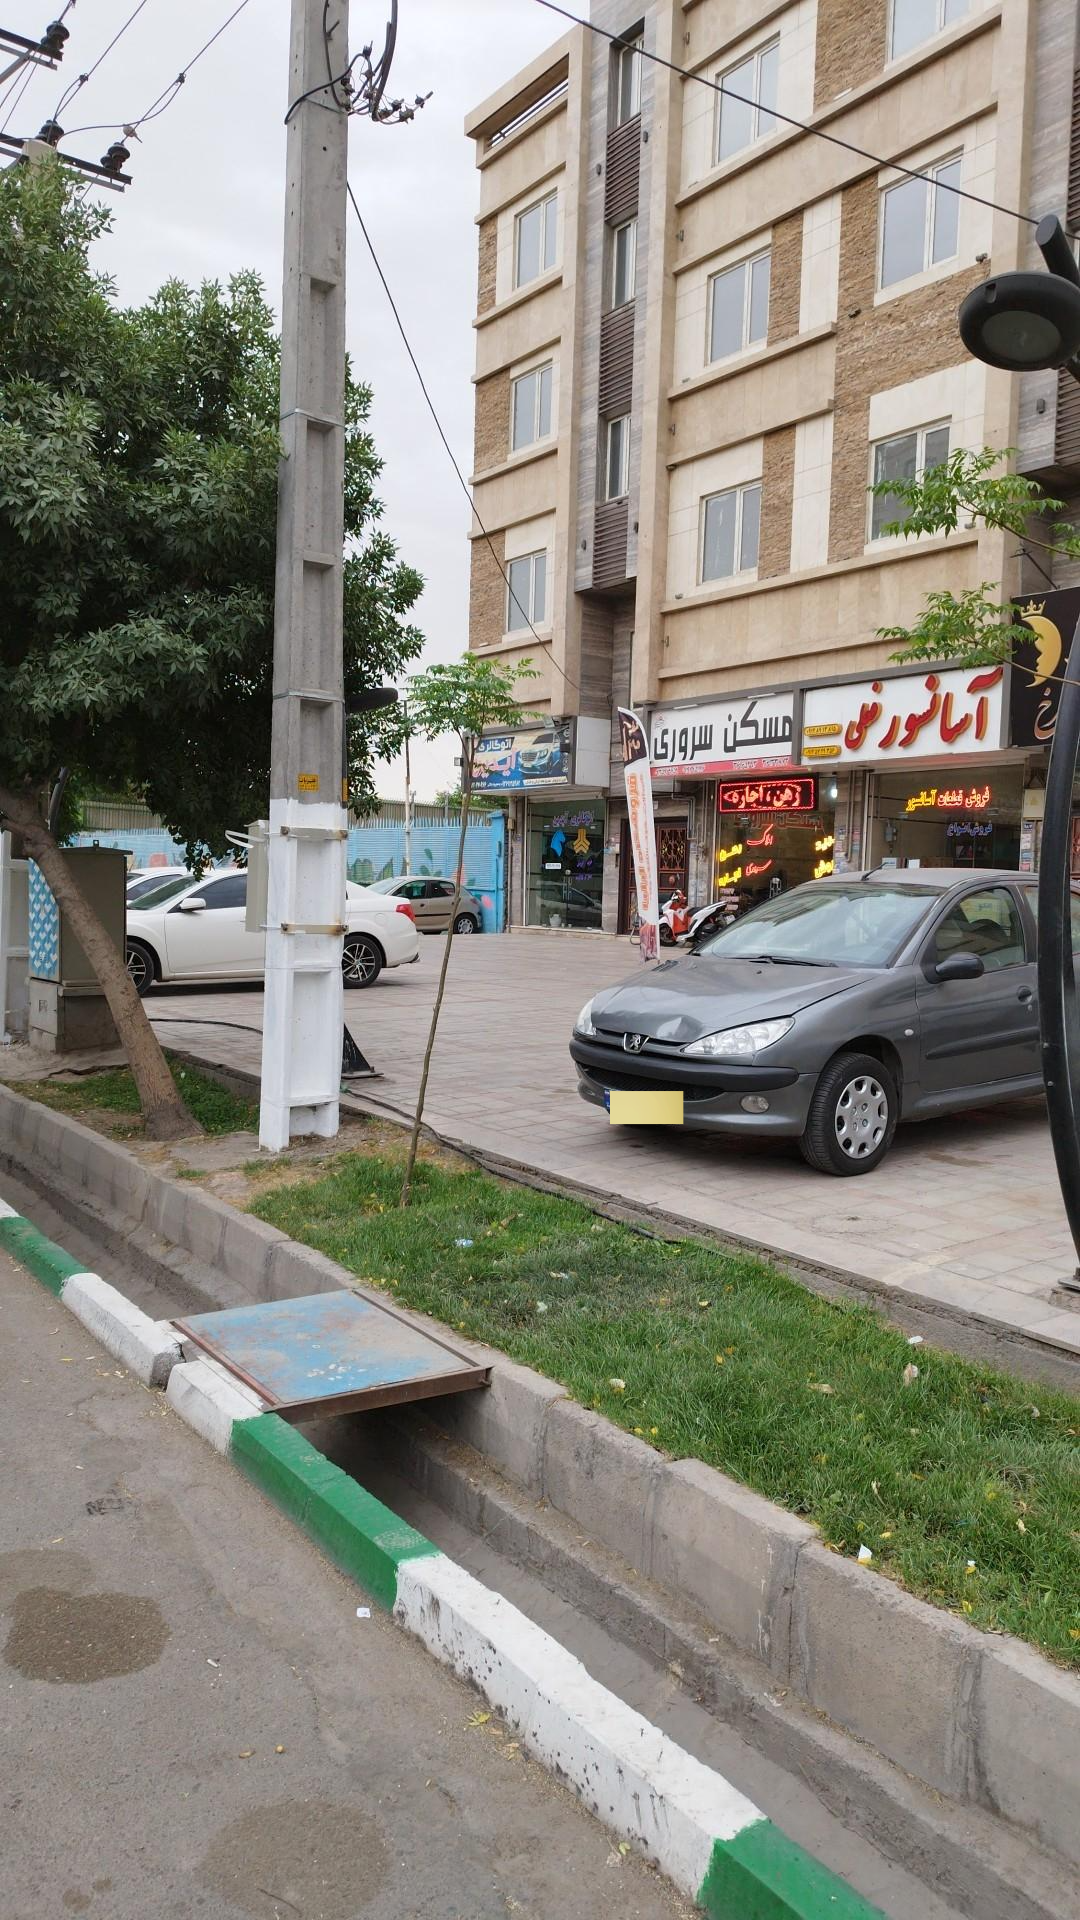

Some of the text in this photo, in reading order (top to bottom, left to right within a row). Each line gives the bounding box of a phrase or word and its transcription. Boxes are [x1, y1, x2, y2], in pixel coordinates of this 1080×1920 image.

[724, 700, 793, 753] مسکن
[878, 667, 1003, 749] آسانسور
[654, 724, 714, 763] سروری
[731, 785, 763, 809] اجاره
[906, 786, 990, 811] فروش قطعات آسانسور
